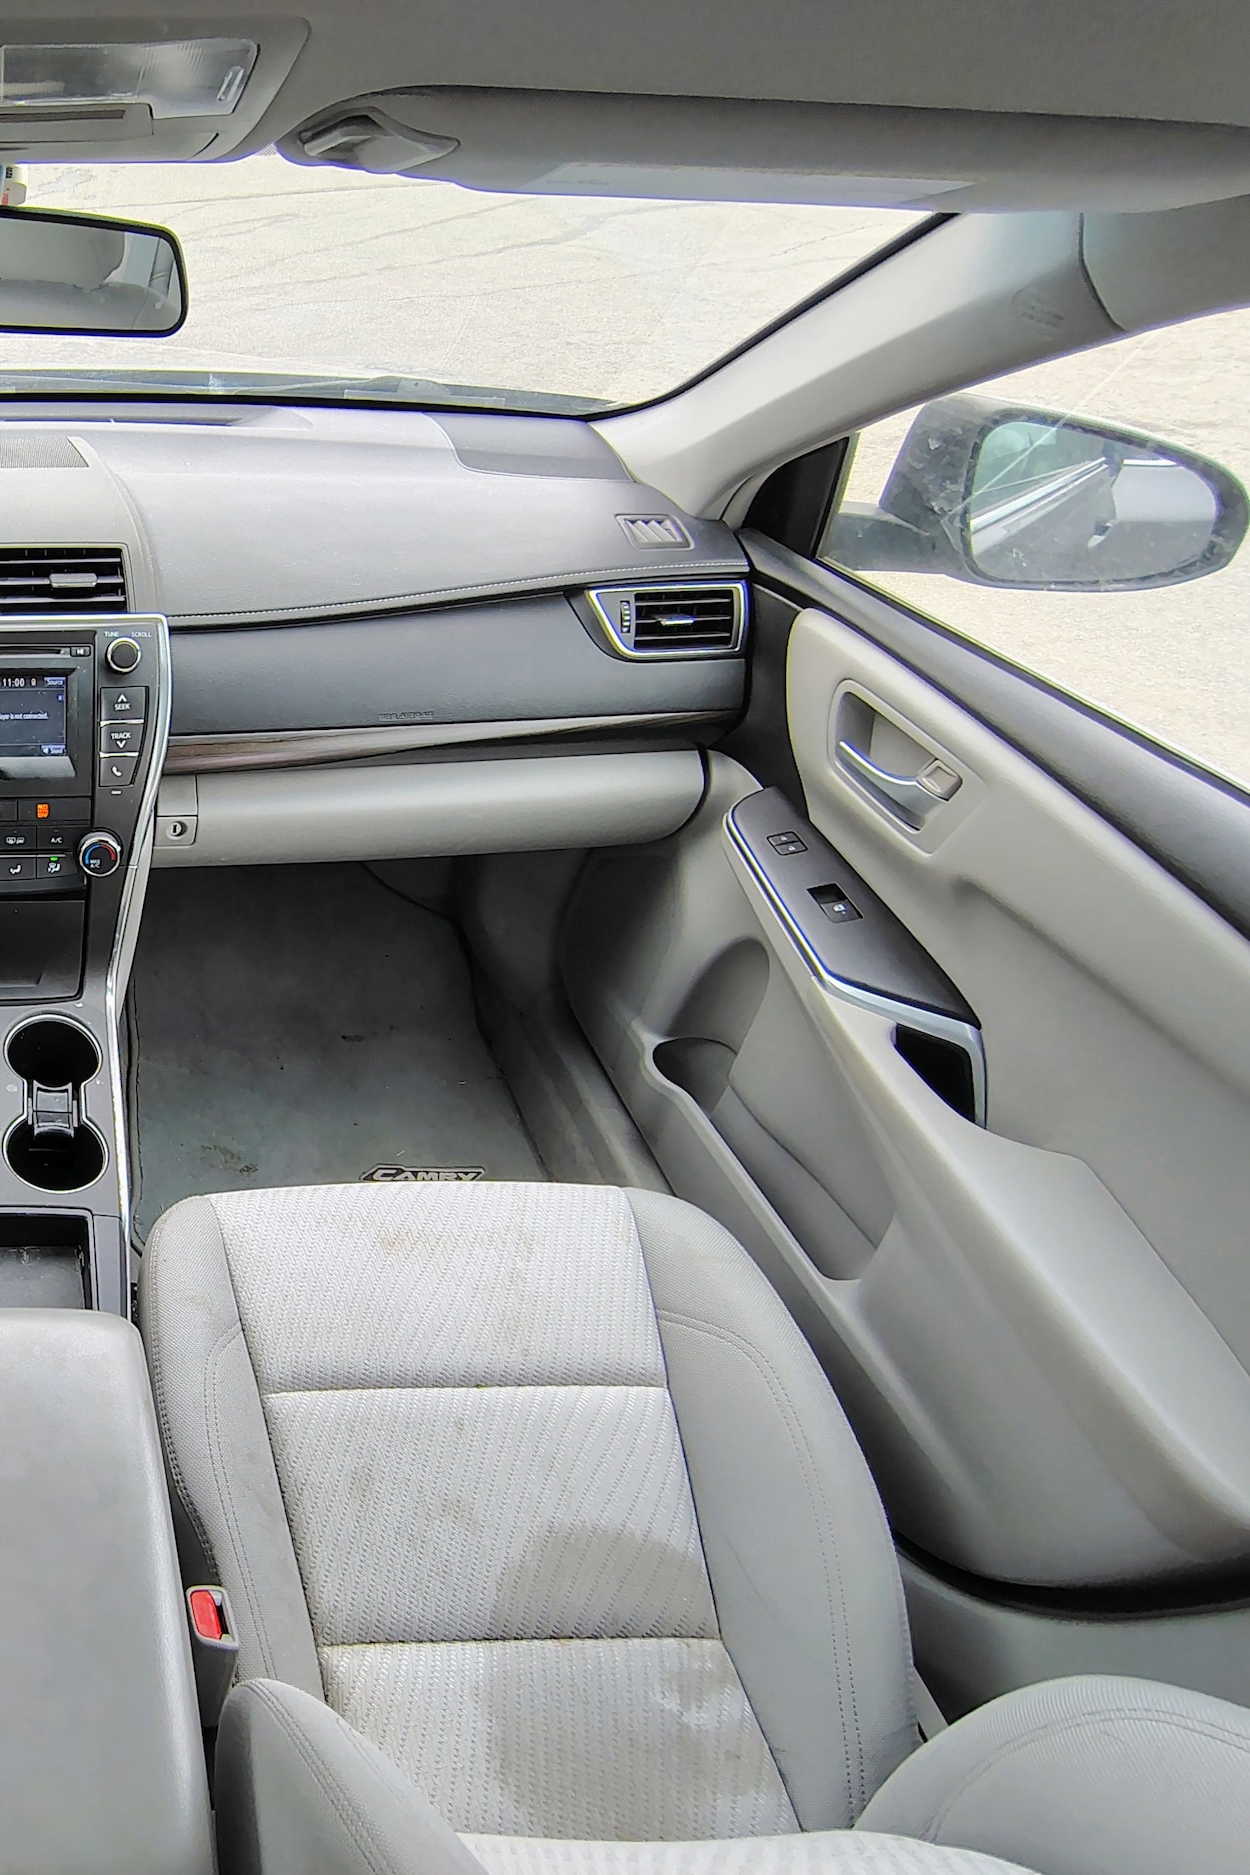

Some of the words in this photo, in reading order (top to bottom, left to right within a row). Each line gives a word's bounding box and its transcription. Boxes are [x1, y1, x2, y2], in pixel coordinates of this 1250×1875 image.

[2, 678, 25, 687] 11:00
[46, 679, 64, 687] Source
[114, 703, 131, 711] SEEK
[111, 731, 132, 740] TRACK
[371, 1169, 477, 1181] CAMRY
